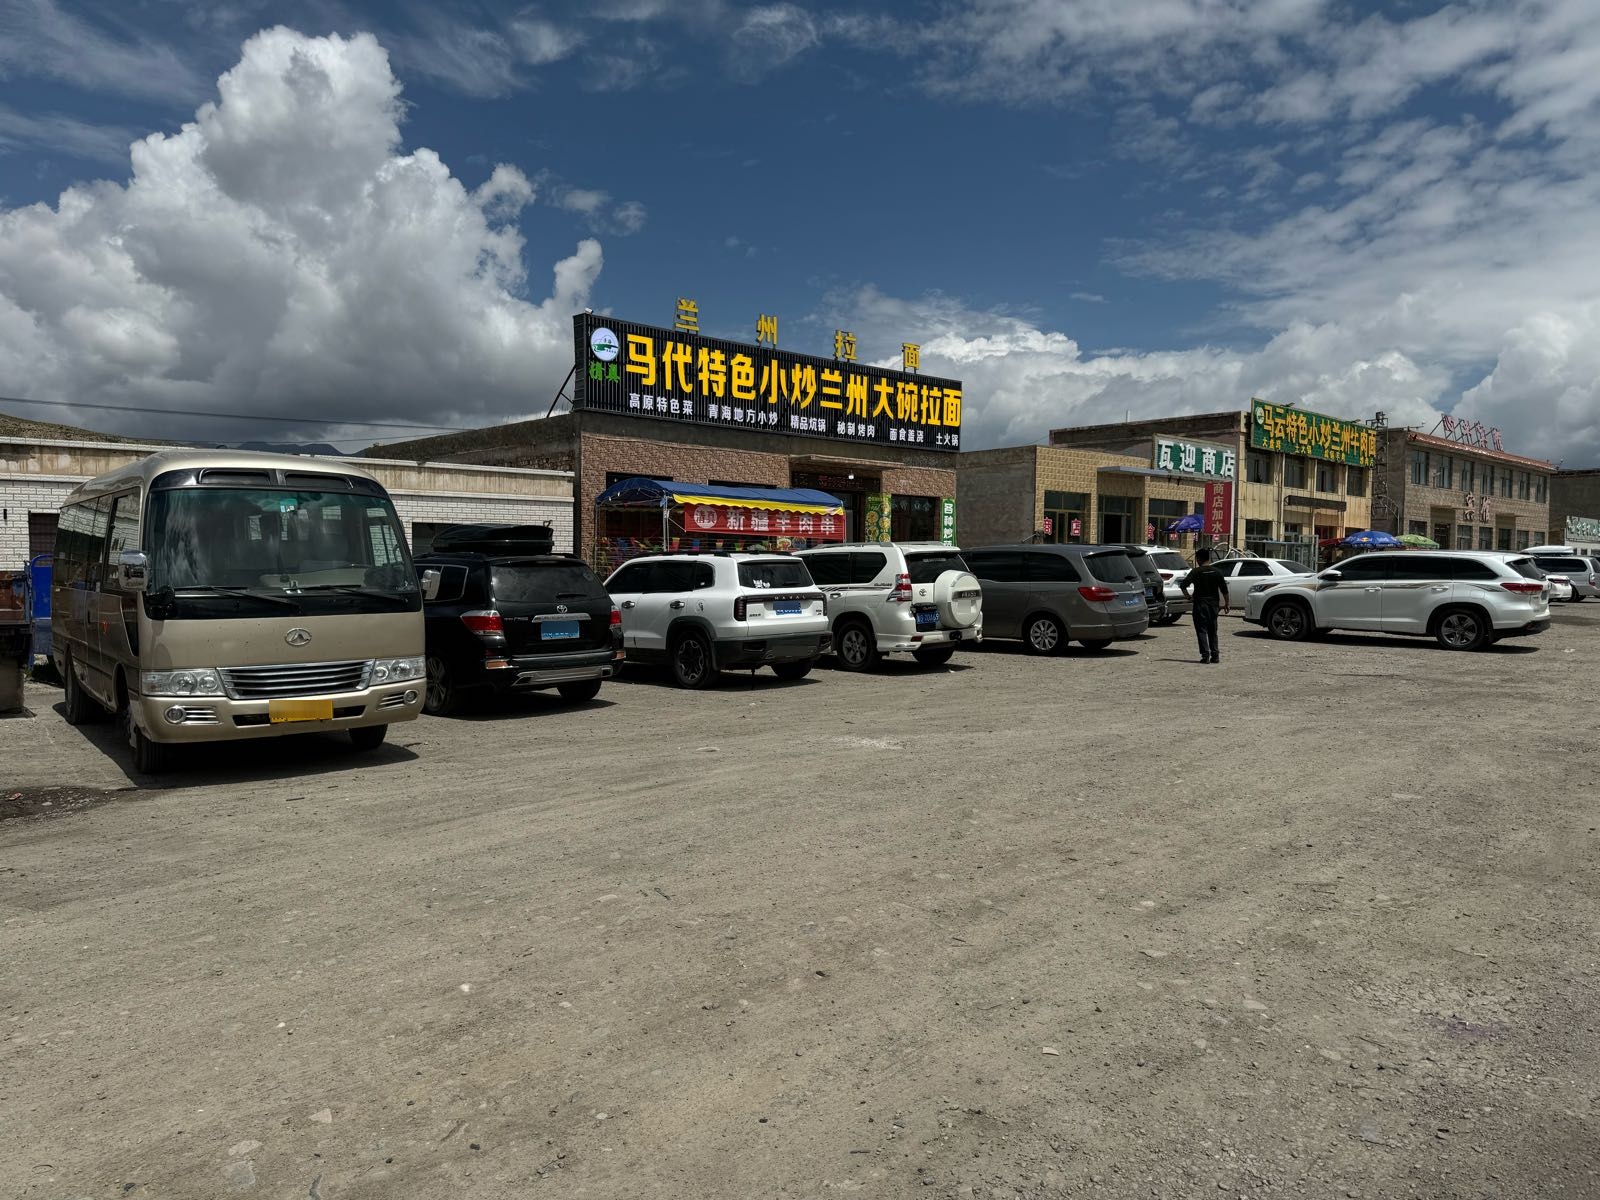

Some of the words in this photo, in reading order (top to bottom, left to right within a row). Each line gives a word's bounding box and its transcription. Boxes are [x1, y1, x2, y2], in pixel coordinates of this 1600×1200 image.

[676, 299, 921, 370] 兰州拉面
[625, 333, 961, 427] 马代特色小炒兰州大碗拉面
[629, 393, 693, 415] 高原特色菜
[708, 403, 778, 425] 青海地方小炒
[790, 415, 826, 432] 精品炕锅
[837, 421, 875, 438] 秘制烤肉
[889, 428, 924, 443] 面食盖浇
[936, 433, 959, 447] 土火锅
[1263, 405, 1377, 458] 马云特色小炒兰州牛肉面
[1158, 439, 1235, 478] 瓦迎商店
[727, 507, 833, 535] 新疆羊肉串
[1211, 483, 1225, 534] 商店加水
